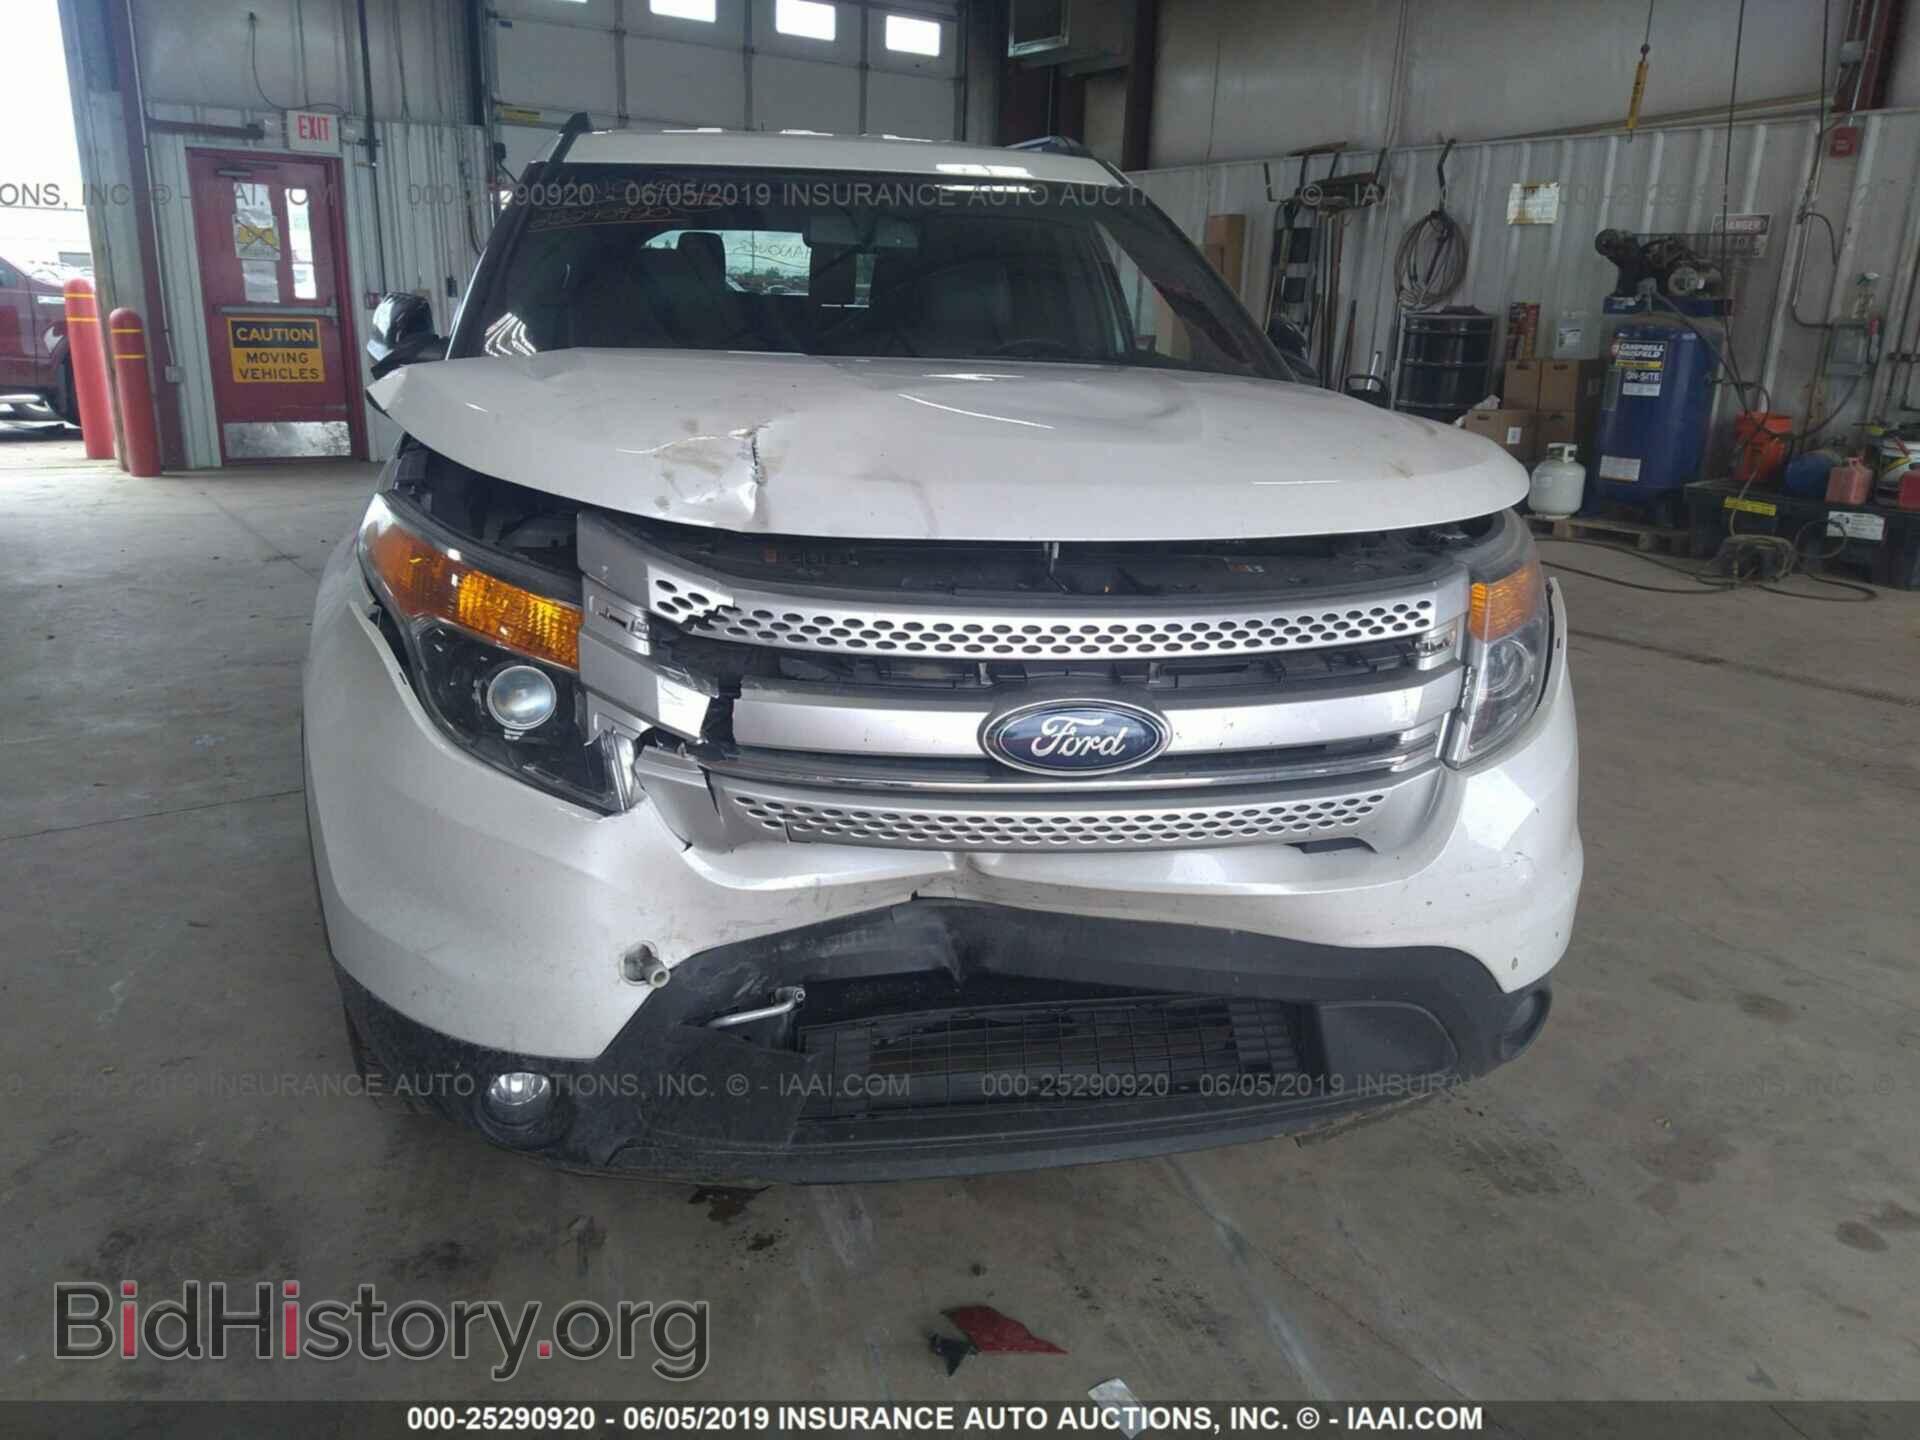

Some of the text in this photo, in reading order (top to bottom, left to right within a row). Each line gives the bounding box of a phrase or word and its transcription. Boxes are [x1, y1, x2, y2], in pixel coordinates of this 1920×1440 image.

[297, 114, 330, 140] EXIT
[236, 327, 315, 342] CAUTION
[246, 352, 309, 364] MOVING
[239, 368, 320, 381] VEHICLES
[1031, 716, 1128, 757] Ford
